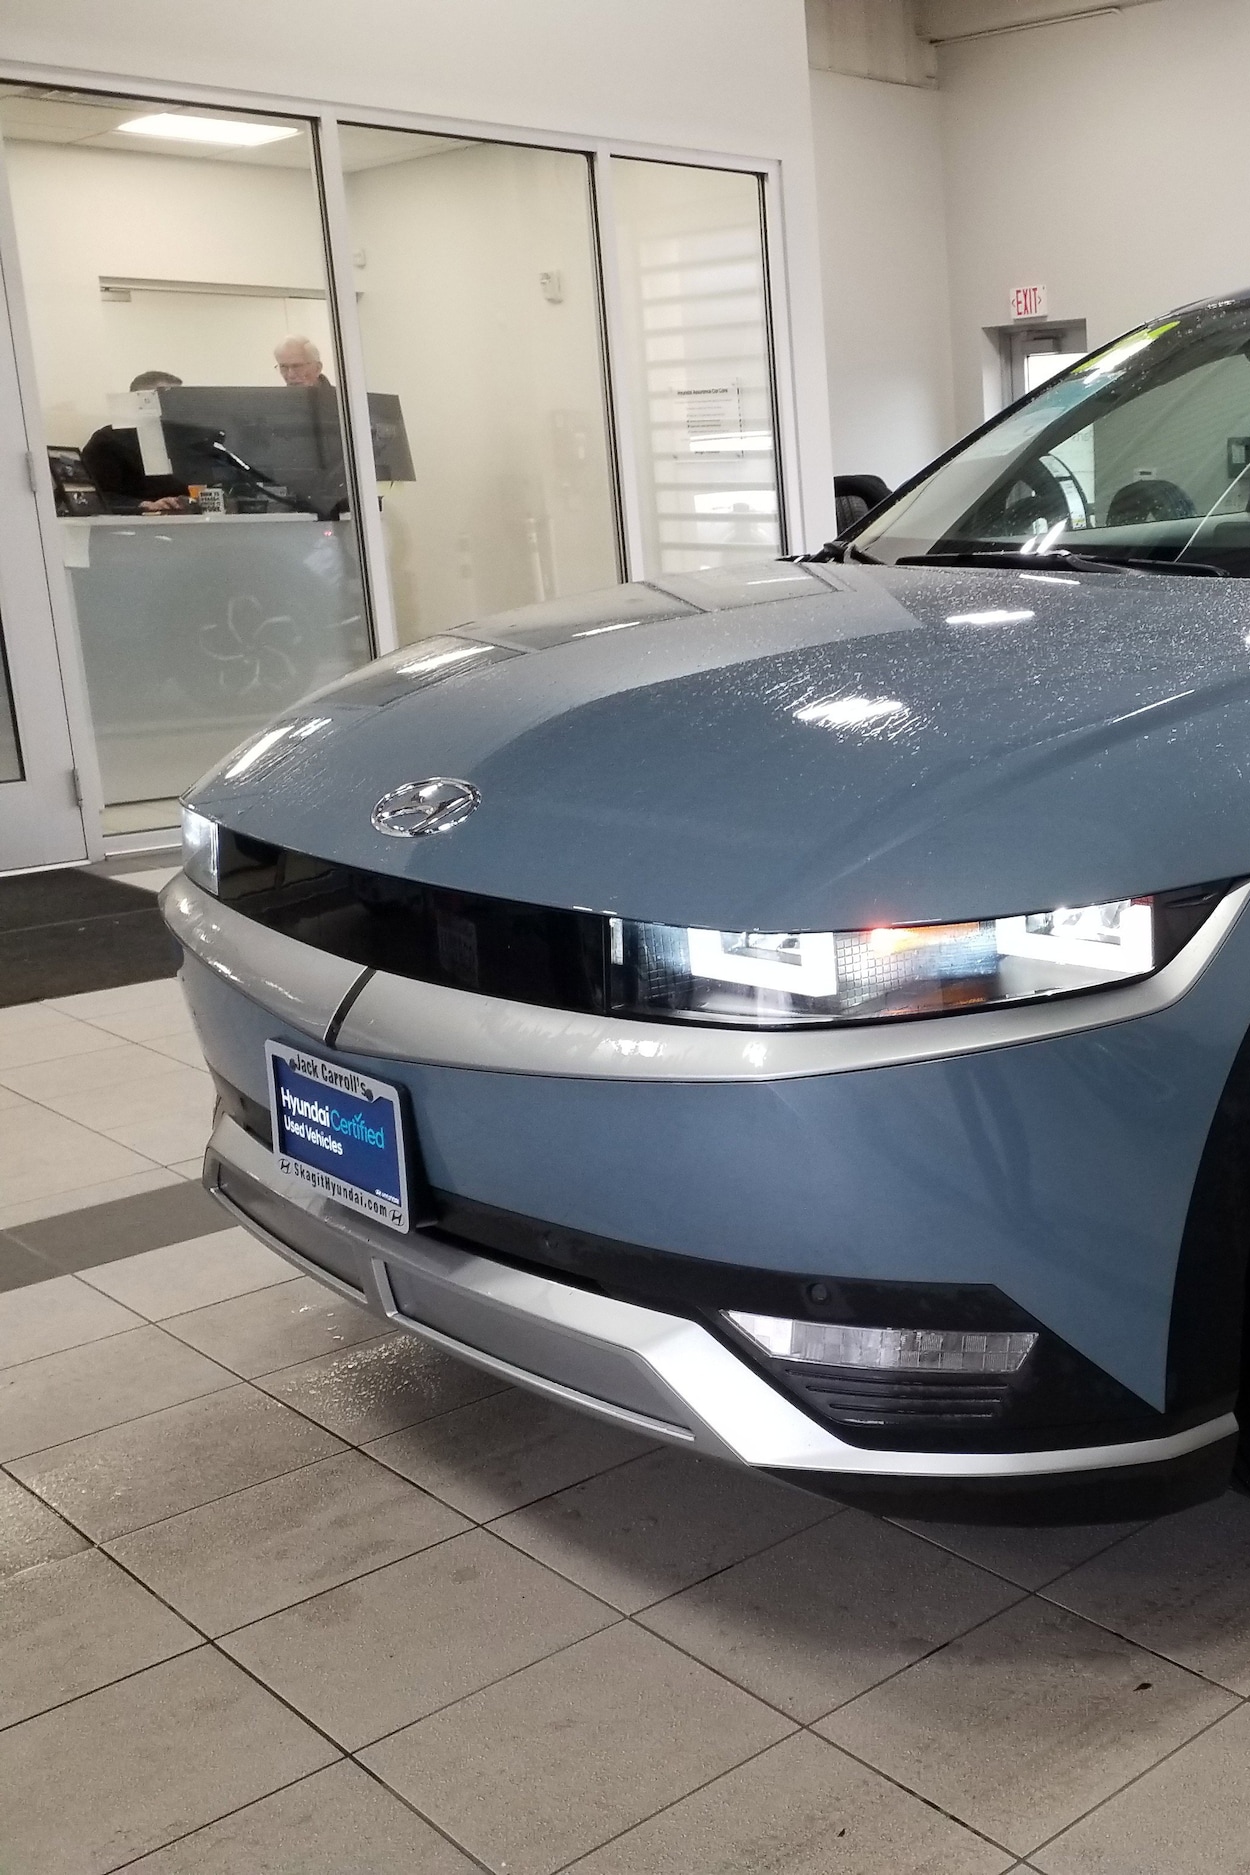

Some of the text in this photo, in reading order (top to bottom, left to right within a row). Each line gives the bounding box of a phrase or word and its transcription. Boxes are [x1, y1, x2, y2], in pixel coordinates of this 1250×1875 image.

[1015, 287, 1038, 316] EXIT
[294, 1054, 366, 1096] Jack Carroll's
[280, 1086, 385, 1149] Hyundai Certified
[283, 1114, 344, 1156] Used Vehicles
[294, 1162, 388, 1218] SkagitHyundai.com
